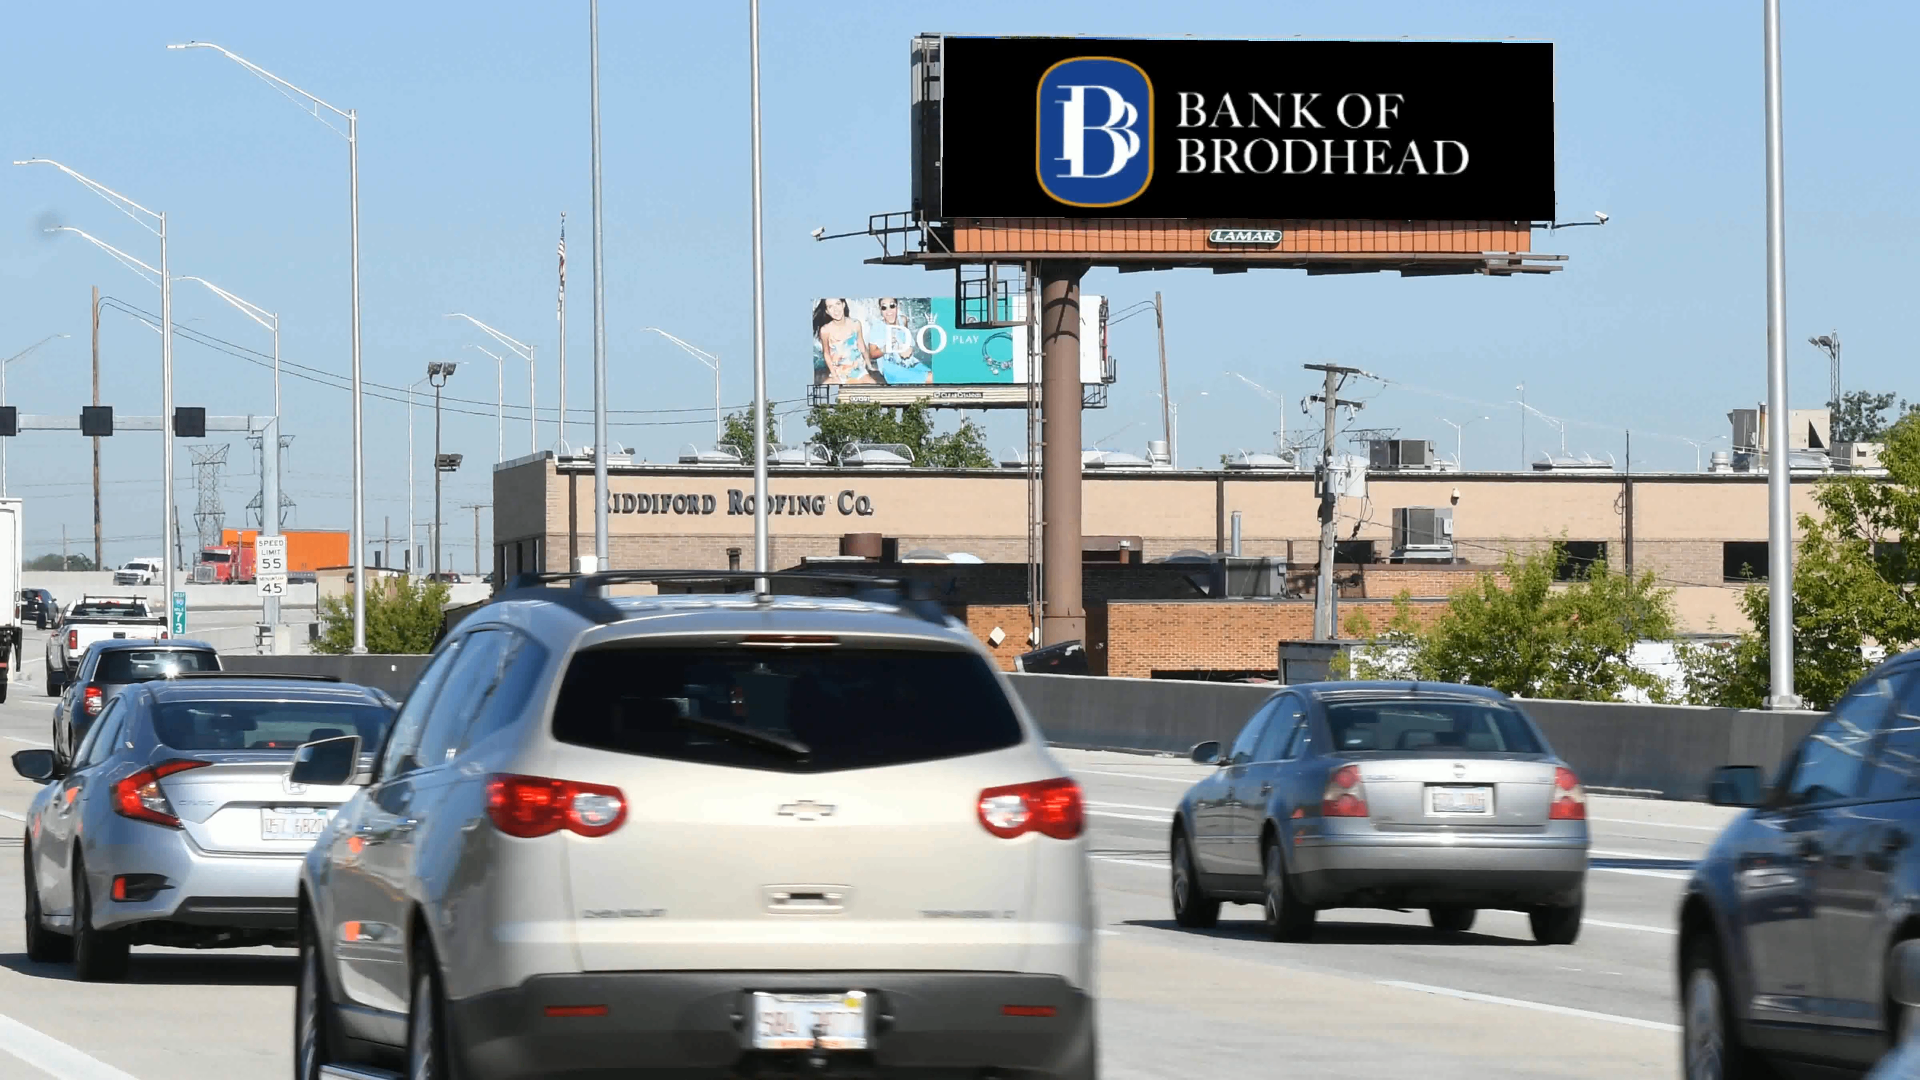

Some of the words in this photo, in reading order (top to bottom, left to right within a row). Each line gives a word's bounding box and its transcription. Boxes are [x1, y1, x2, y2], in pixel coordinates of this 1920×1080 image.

[1177, 92, 1324, 129] BANK
[1336, 93, 1405, 129] OF
[1177, 138, 1470, 175] BRODHEAD
[1214, 230, 1276, 242] LAMAR
[885, 324, 947, 354] DO
[952, 335, 979, 344] PLAY
[594, 488, 717, 515] IDDIFORD
[262, 558, 282, 569] 55
[262, 583, 283, 594] 45
